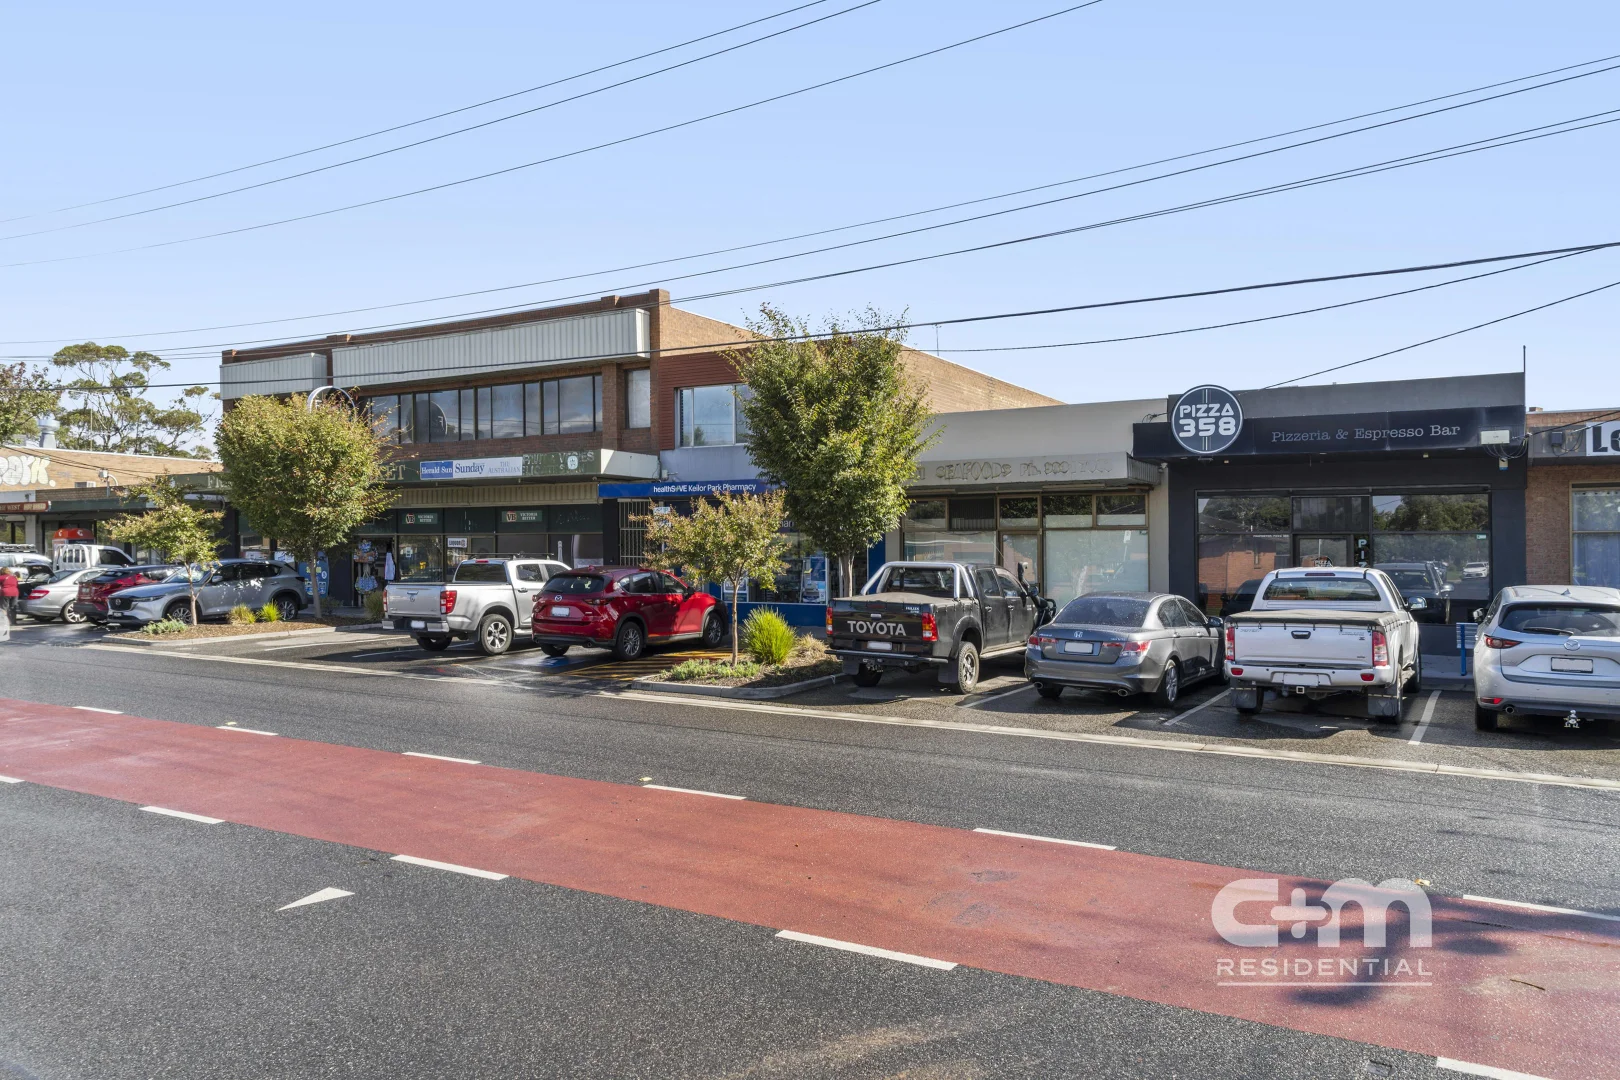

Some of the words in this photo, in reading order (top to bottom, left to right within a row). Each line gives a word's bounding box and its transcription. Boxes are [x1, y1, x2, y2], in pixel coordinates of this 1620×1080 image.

[1180, 403, 1234, 418] PIZZA
[1179, 417, 1236, 437] 358
[1271, 430, 1331, 442] Pizzeria
[1335, 429, 1349, 440] &
[1354, 427, 1424, 441] Espresso
[1430, 425, 1461, 436] Bar
[441, 466, 453, 474] Sun
[455, 462, 485, 474] Sunday
[488, 466, 520, 474] AUSTRALIAN
[935, 462, 1012, 481] SEAFOODS
[722, 483, 757, 491] Pharmacy
[506, 513, 516, 521] VB
[847, 620, 906, 636] TOYOTA
